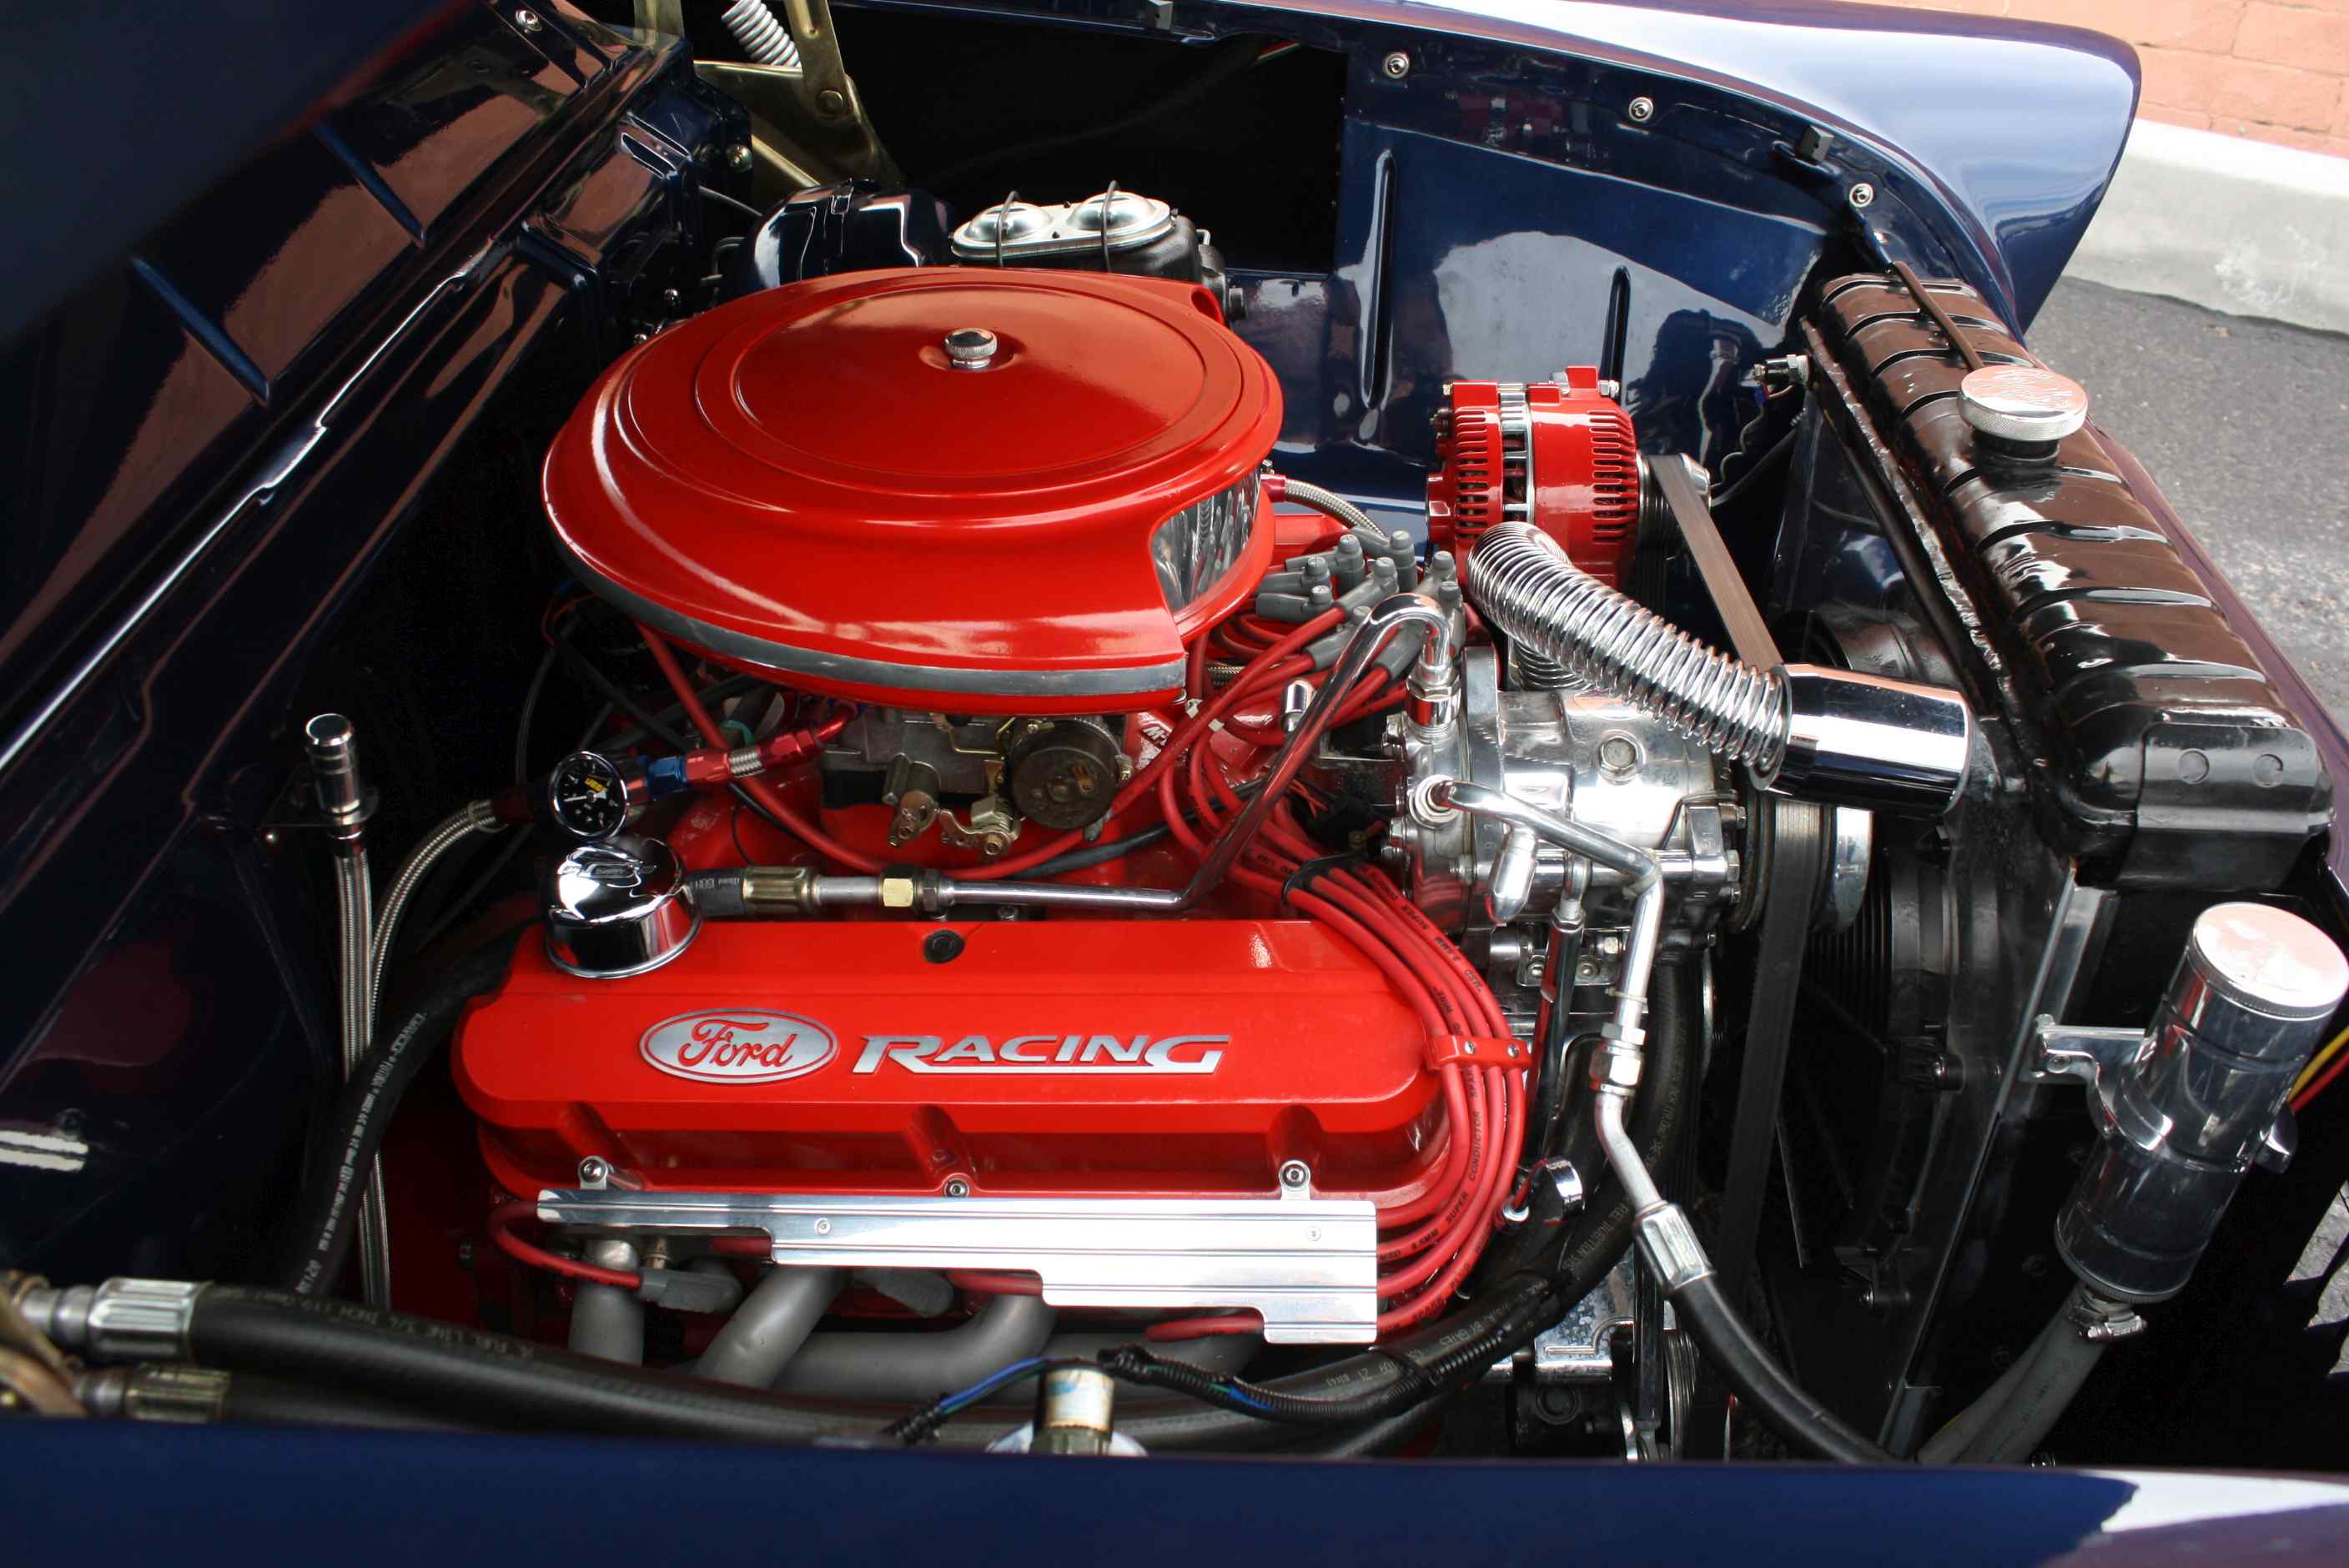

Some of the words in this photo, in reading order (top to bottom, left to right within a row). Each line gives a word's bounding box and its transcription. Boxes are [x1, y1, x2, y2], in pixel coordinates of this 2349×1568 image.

[677, 1019, 793, 1066] Ford
[851, 1034, 1231, 1074] RACING
[1446, 1192, 1468, 1224] SUPER
[1467, 1111, 1483, 1181] CONDUCTOR
